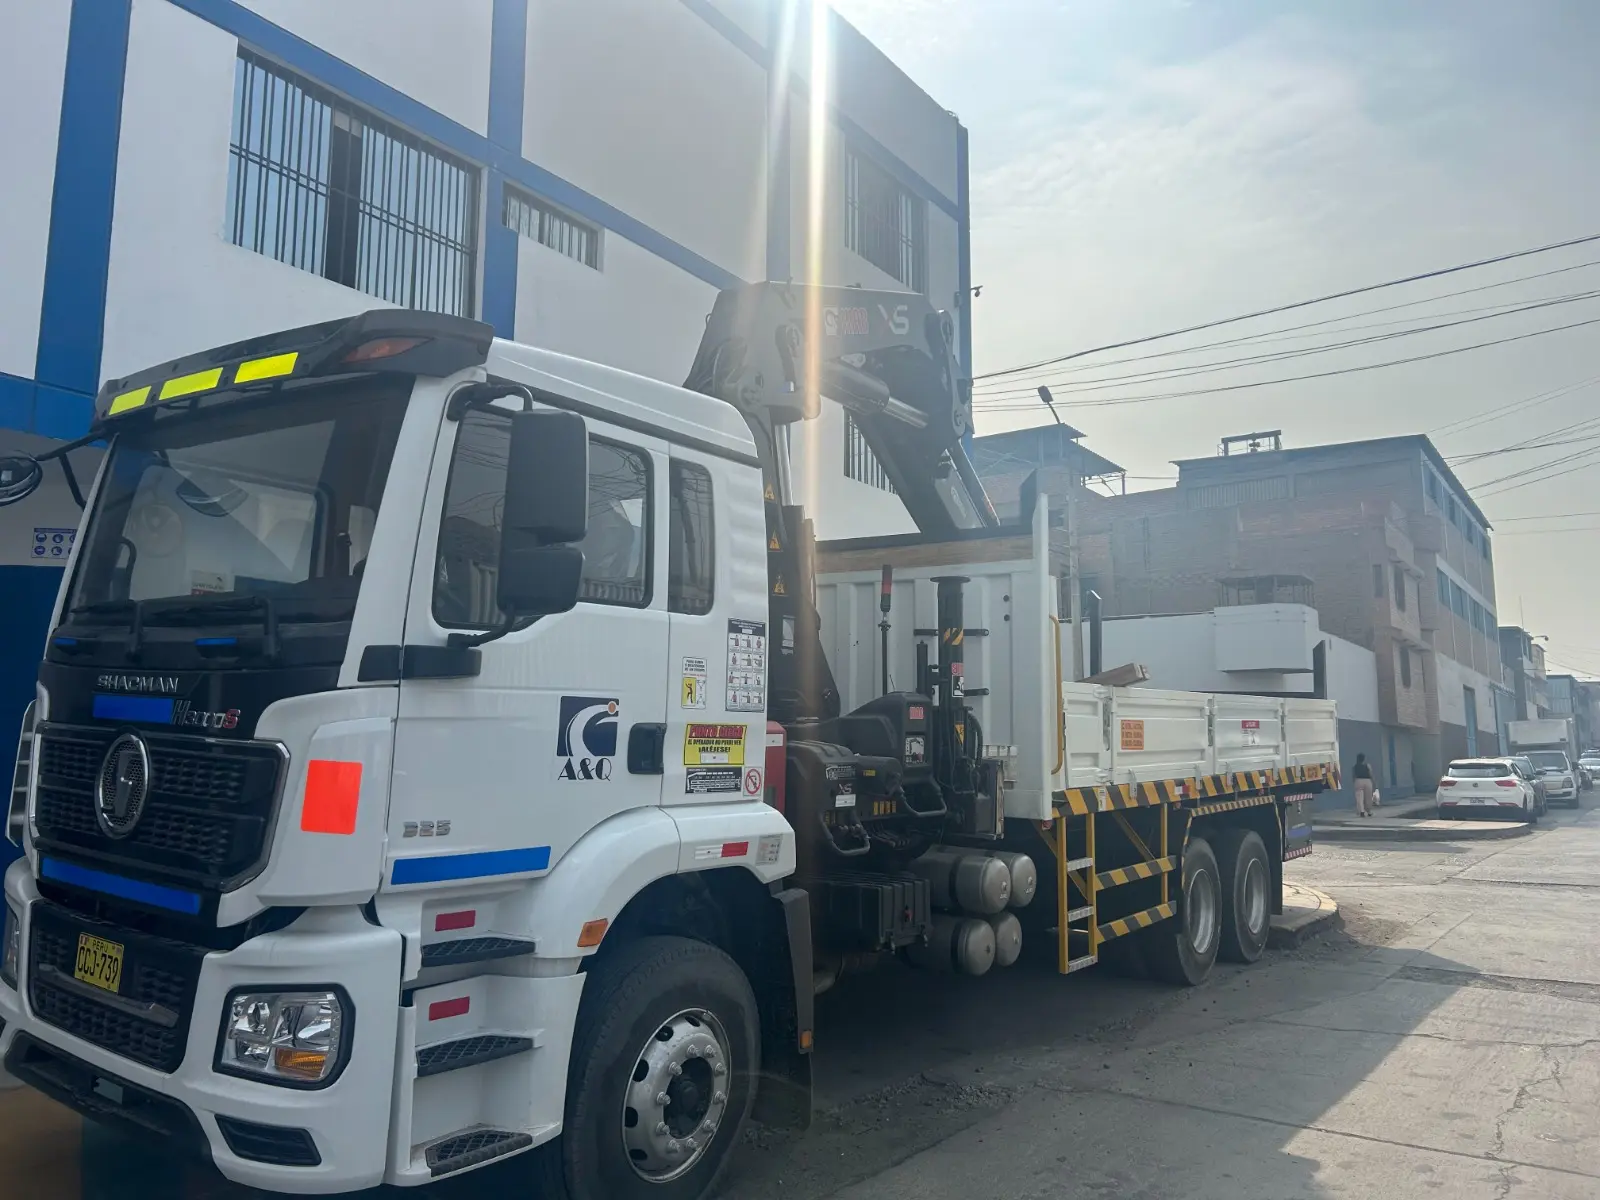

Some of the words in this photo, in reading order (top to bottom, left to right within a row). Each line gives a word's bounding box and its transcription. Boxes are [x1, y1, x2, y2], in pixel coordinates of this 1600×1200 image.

[97, 675, 179, 693] SHACMAN
[557, 757, 613, 782] A&Q
[402, 819, 451, 838] 325
[92, 939, 109, 952] PERU
[77, 945, 119, 984] CCJ-739
